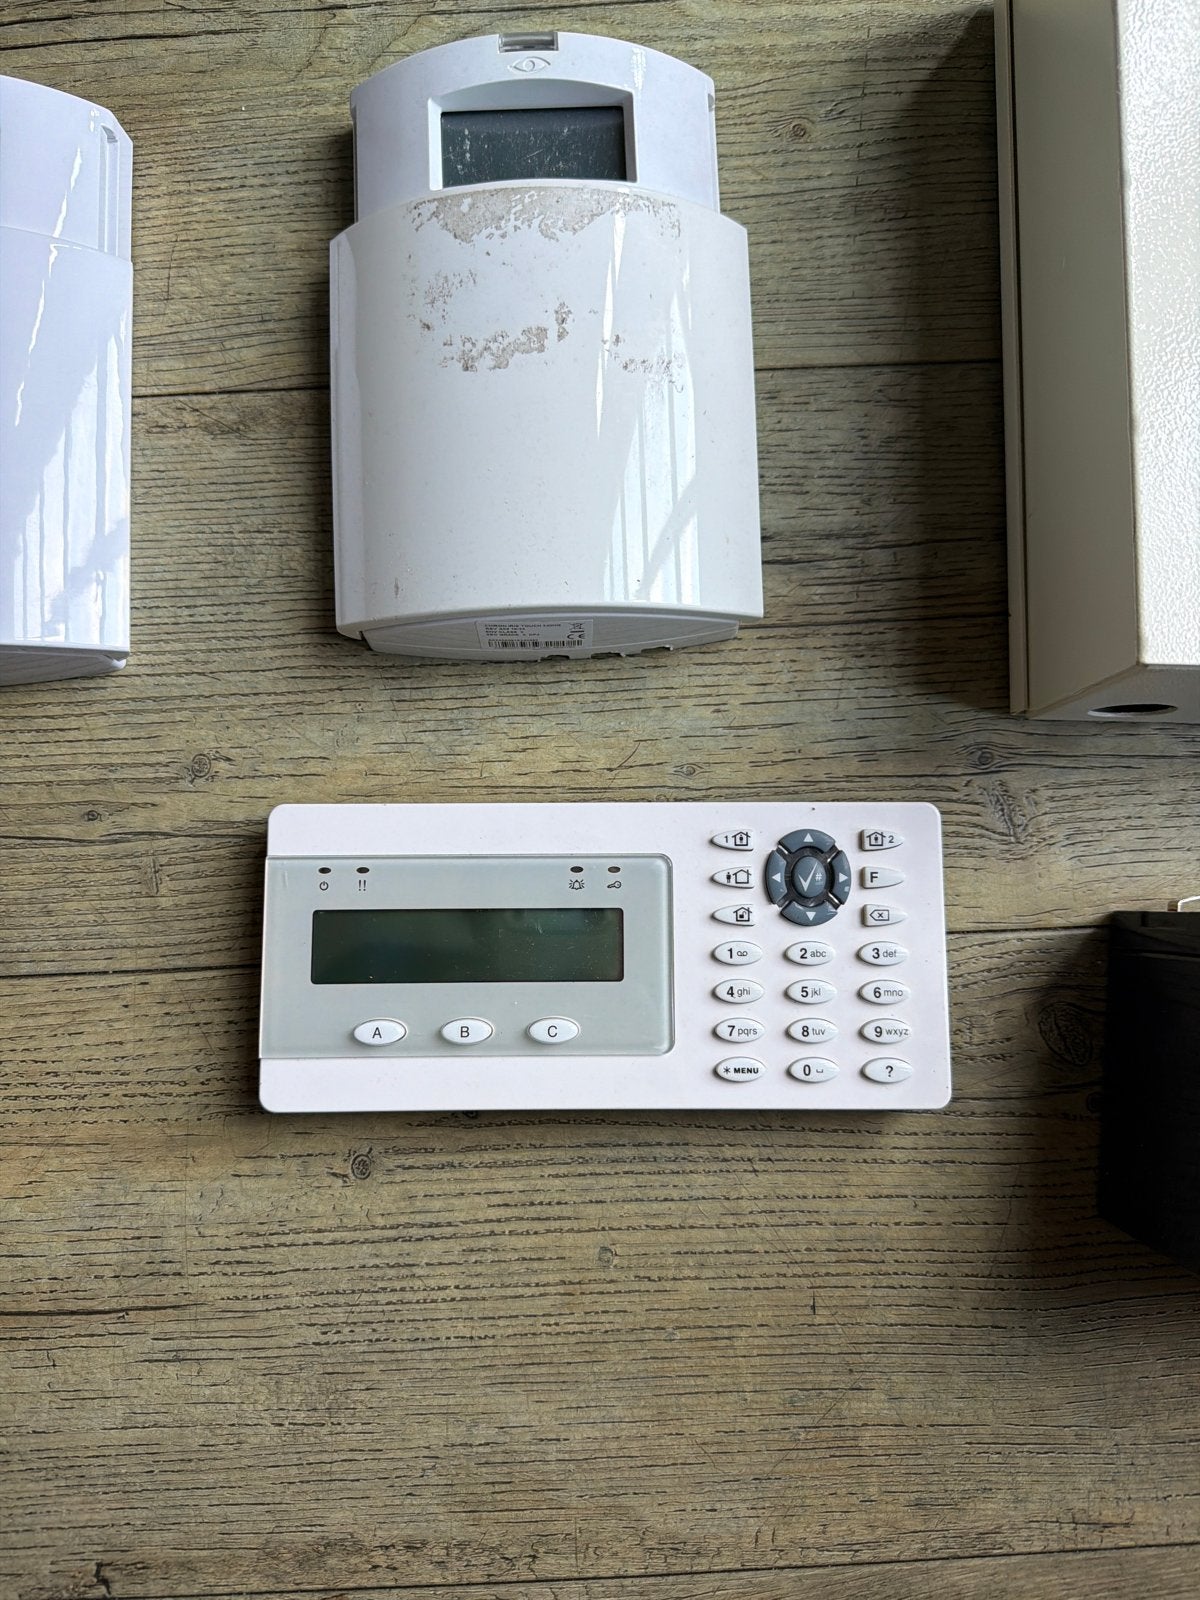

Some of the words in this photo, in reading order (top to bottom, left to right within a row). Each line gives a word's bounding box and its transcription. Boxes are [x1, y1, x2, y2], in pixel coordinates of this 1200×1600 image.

[723, 835, 729, 844] 1
[888, 835, 895, 844] 2
[870, 872, 879, 883] F
[727, 948, 734, 959] 1
[799, 948, 808, 959] 2
[810, 948, 827, 958] abc
[871, 948, 880, 959] 3
[882, 948, 897, 958] def
[726, 986, 735, 998] 4
[737, 987, 751, 998] ghi
[800, 986, 809, 998] 5
[811, 987, 821, 999] jkl
[873, 987, 881, 999] 6
[883, 989, 904, 997] mno
[371, 1026, 383, 1039] A
[459, 1025, 471, 1039] B
[546, 1025, 559, 1039] C
[727, 1025, 736, 1037] 7
[737, 1027, 758, 1037] pqrs
[801, 1025, 810, 1037] 8
[811, 1027, 826, 1036] tuv
[874, 1026, 883, 1038] 9
[885, 1027, 909, 1037] wxyz
[733, 1066, 759, 1075] MENU
[802, 1064, 812, 1077] 0
